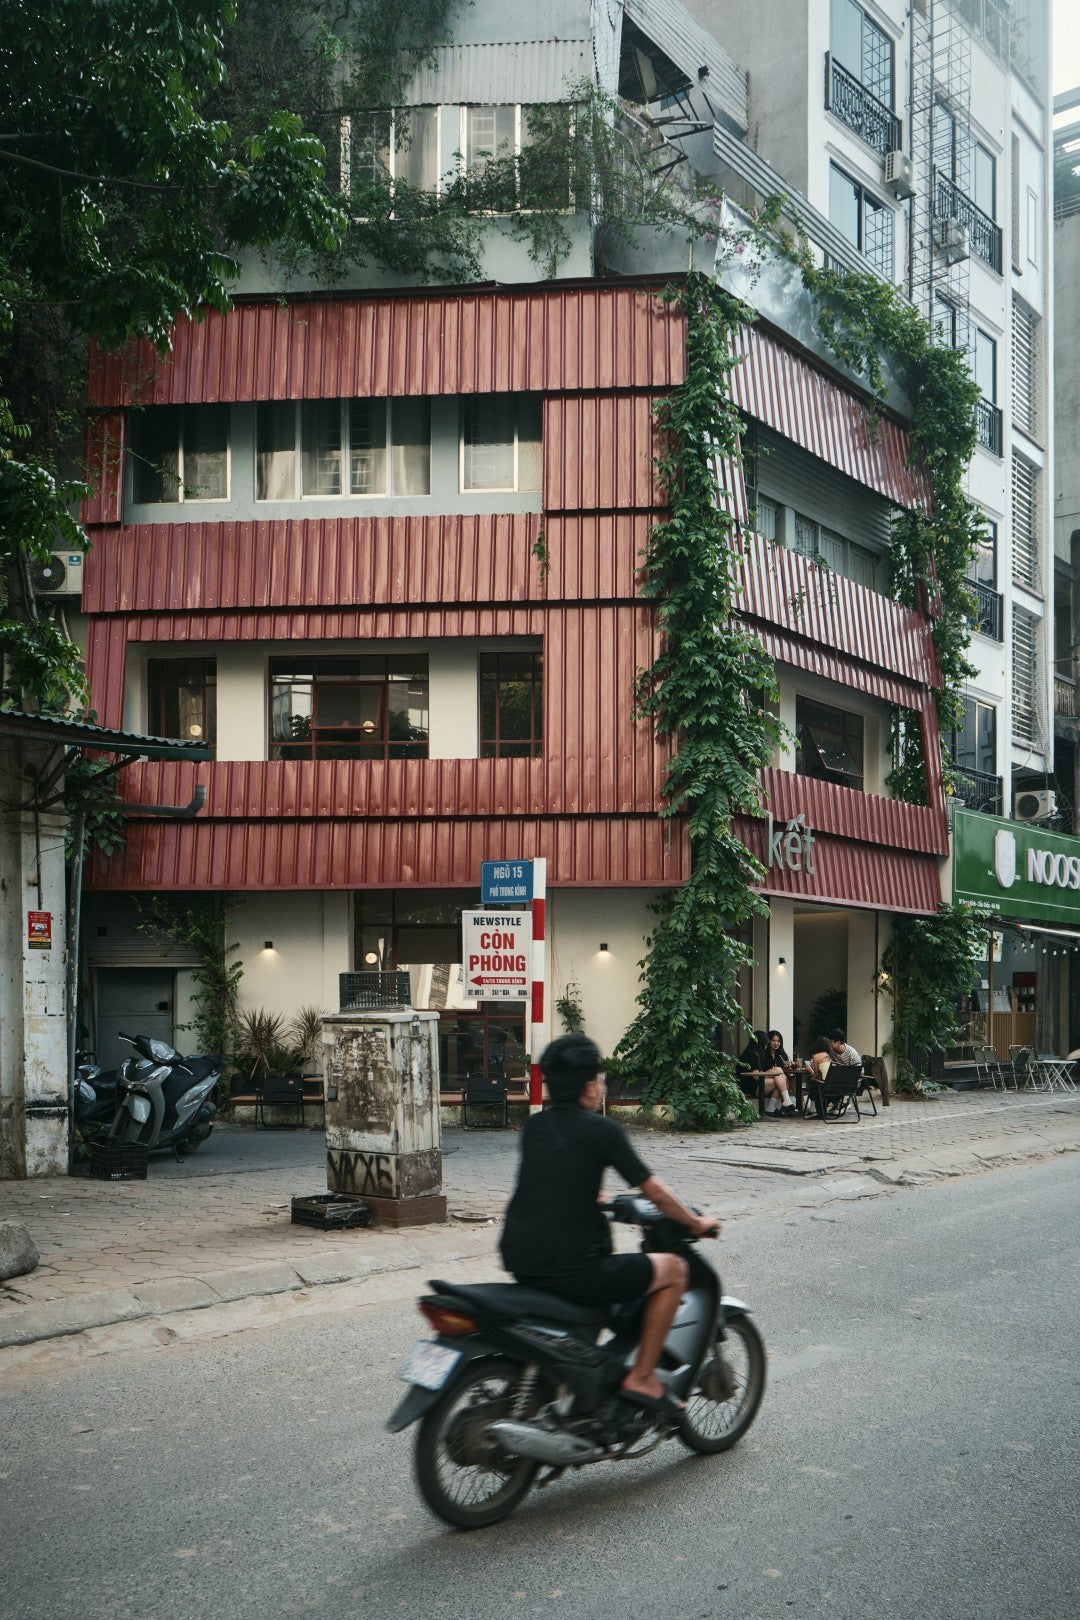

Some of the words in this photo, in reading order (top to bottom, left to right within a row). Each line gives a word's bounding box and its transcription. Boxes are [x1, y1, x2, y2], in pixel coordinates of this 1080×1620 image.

[768, 811, 816, 875] kết
[493, 864, 510, 879] NGÕ
[512, 866, 523, 878] 15
[1027, 848, 1080, 890] NOOS
[473, 917, 522, 926] NEWSTYLE
[480, 928, 515, 950] CÒN
[469, 950, 526, 972] PHÒNG
